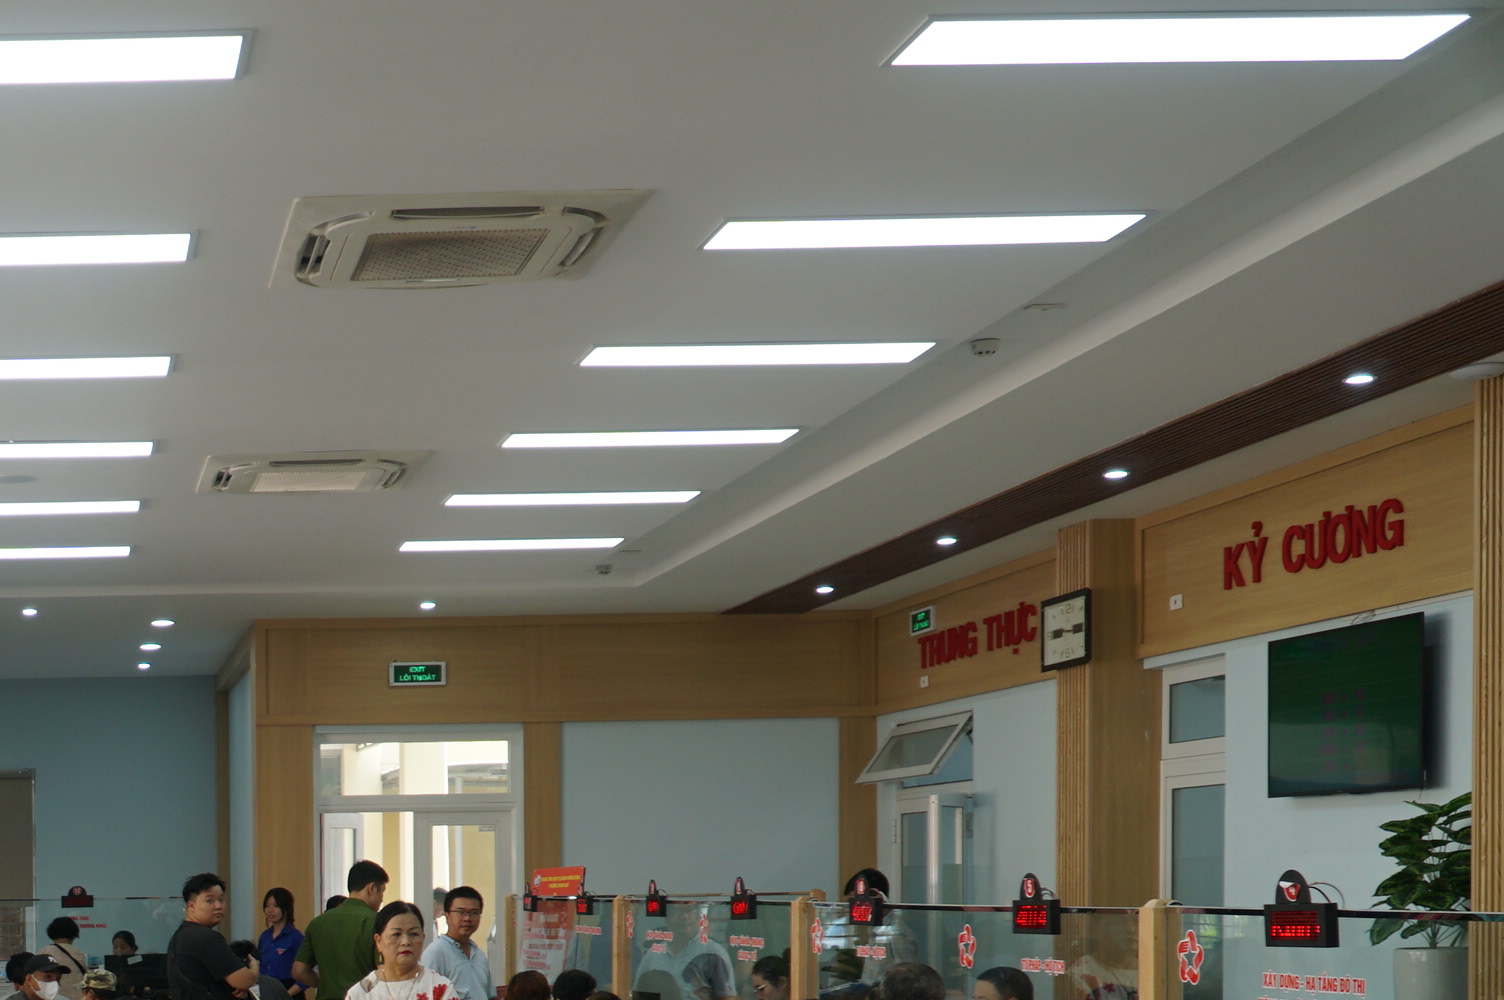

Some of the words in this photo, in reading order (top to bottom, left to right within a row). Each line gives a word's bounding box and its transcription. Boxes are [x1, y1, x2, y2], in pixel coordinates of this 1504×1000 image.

[1224, 521, 1268, 590] KỶ
[1282, 498, 1404, 573] CƯƠNG
[918, 622, 978, 669] TRUNG
[983, 602, 1038, 654] THỰC
[1263, 969, 1277, 988] XÂY
[1279, 973, 1300, 992] DỰNG
[1305, 975, 1316, 995] HẠ
[1340, 974, 1351, 994] ĐÔ
[1353, 978, 1366, 998] THỊ
